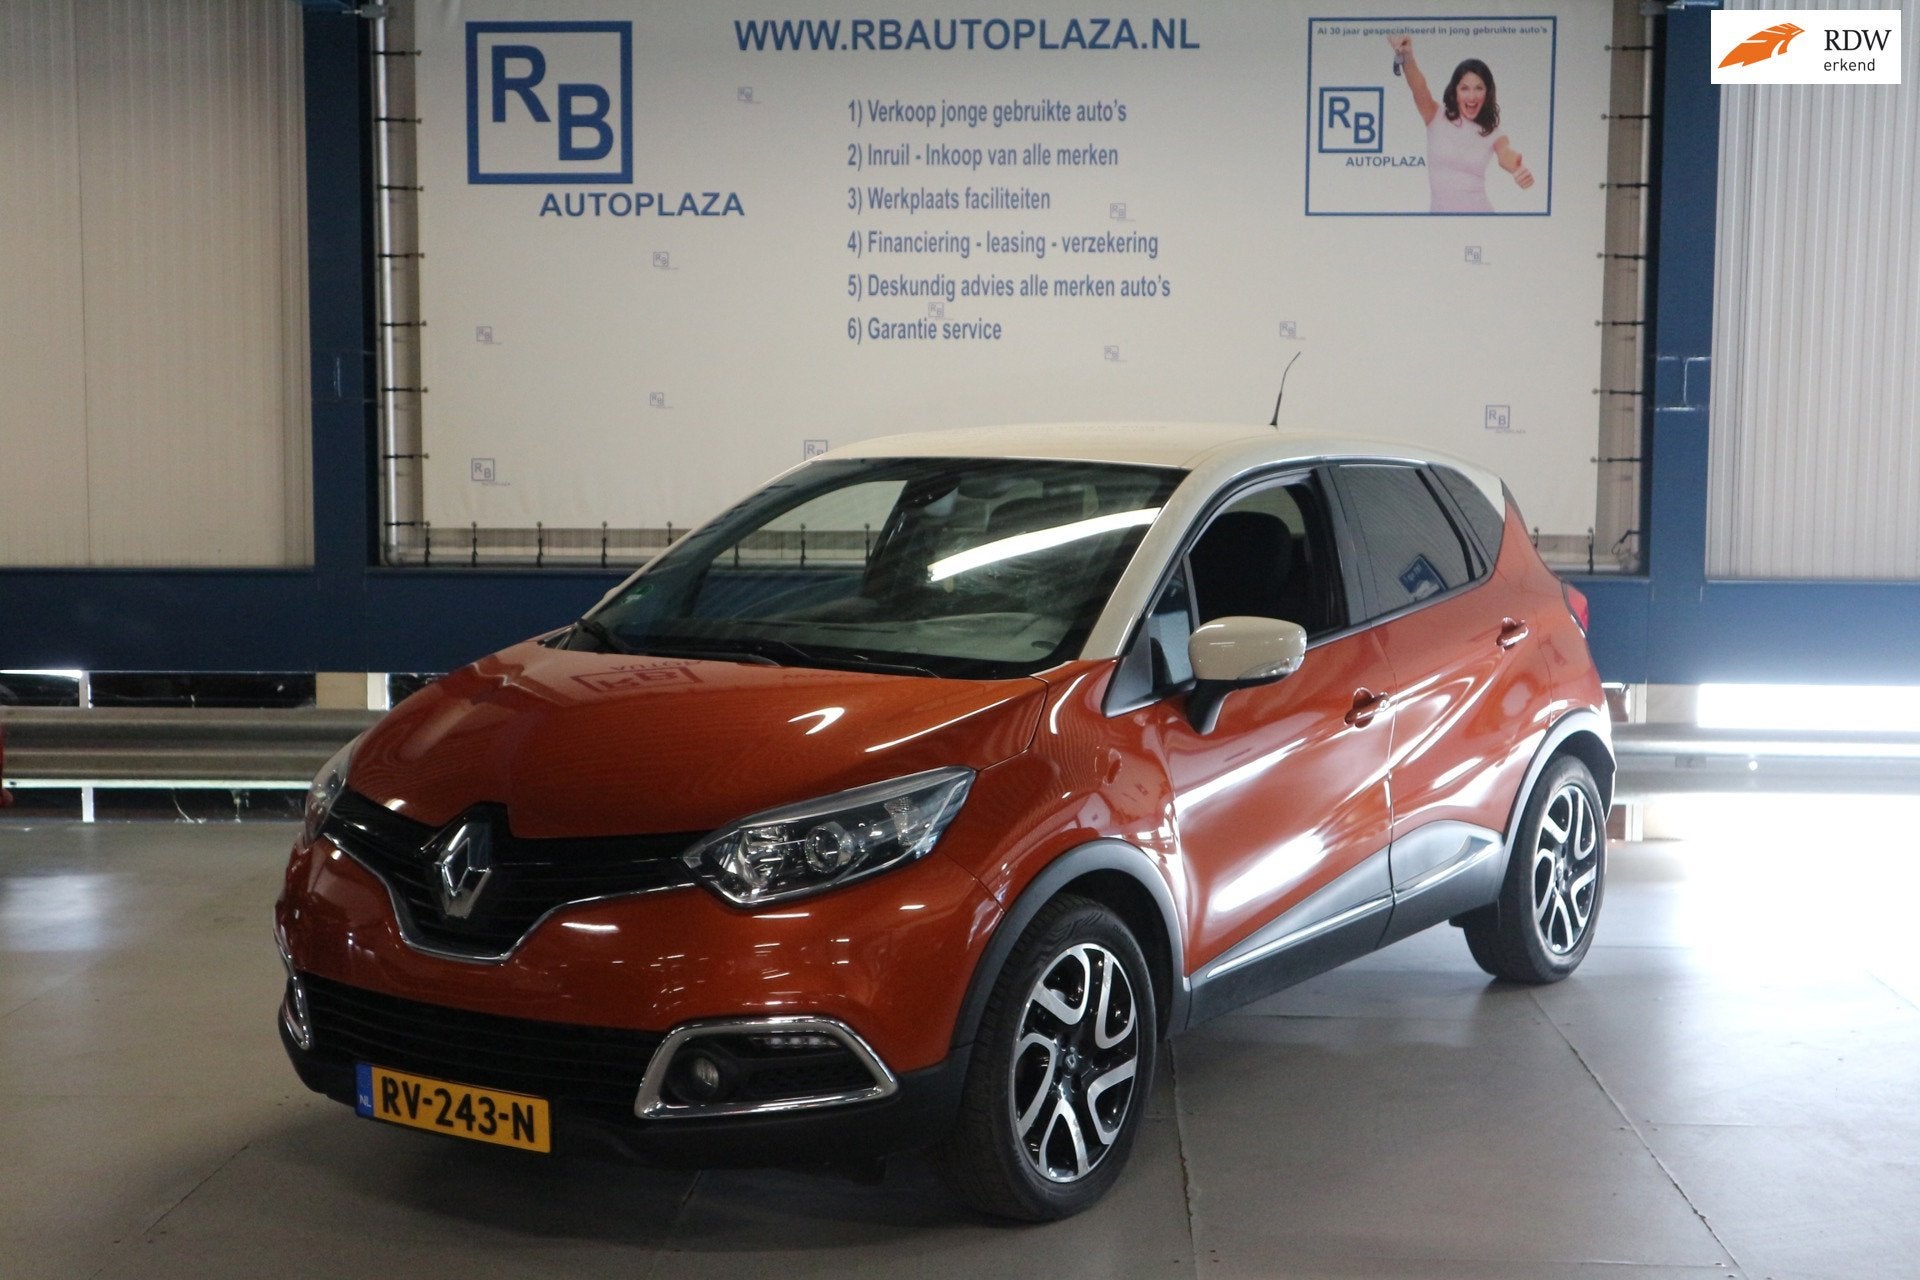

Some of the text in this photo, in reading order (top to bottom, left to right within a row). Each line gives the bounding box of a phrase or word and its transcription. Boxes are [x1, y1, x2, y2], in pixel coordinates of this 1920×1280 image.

[734, 18, 1200, 51] WWW.RBAUTOPLAZA.NL
[1330, 27, 1341, 35] 30
[1343, 27, 1360, 36] jaar
[1363, 26, 1436, 36] gespecialiseerd
[1438, 26, 1447, 34] in
[1449, 26, 1470, 36] jong
[1472, 25, 1517, 35] gebruikte
[1519, 25, 1548, 35] auto's
[491, 45, 614, 161] RB
[849, 99, 1126, 128] 1) Verkoop jonge gebruikte auto's
[1328, 96, 1376, 144] RB
[848, 143, 862, 171] 2)
[868, 143, 909, 165] Inruil
[926, 143, 982, 171] Inkoop
[988, 149, 1017, 166] van
[1023, 143, 1051, 165] alle
[1057, 143, 1118, 165] merken
[1345, 156, 1426, 167] AUTOPLAZA
[539, 192, 745, 217] AUTOPLAZA
[848, 187, 1050, 215] 3) Werkplaats faciliteiten
[847, 231, 862, 258] 4)
[868, 231, 970, 259] Financiering
[987, 231, 1045, 259] leasing
[1062, 231, 1158, 259] verzekering
[848, 274, 1170, 302] 5) Deskundig advies alle merken auto's
[848, 317, 1001, 342] 6) Garantie service
[359, 1094, 372, 1108] NL
[381, 1076, 535, 1144] RV-243-N
